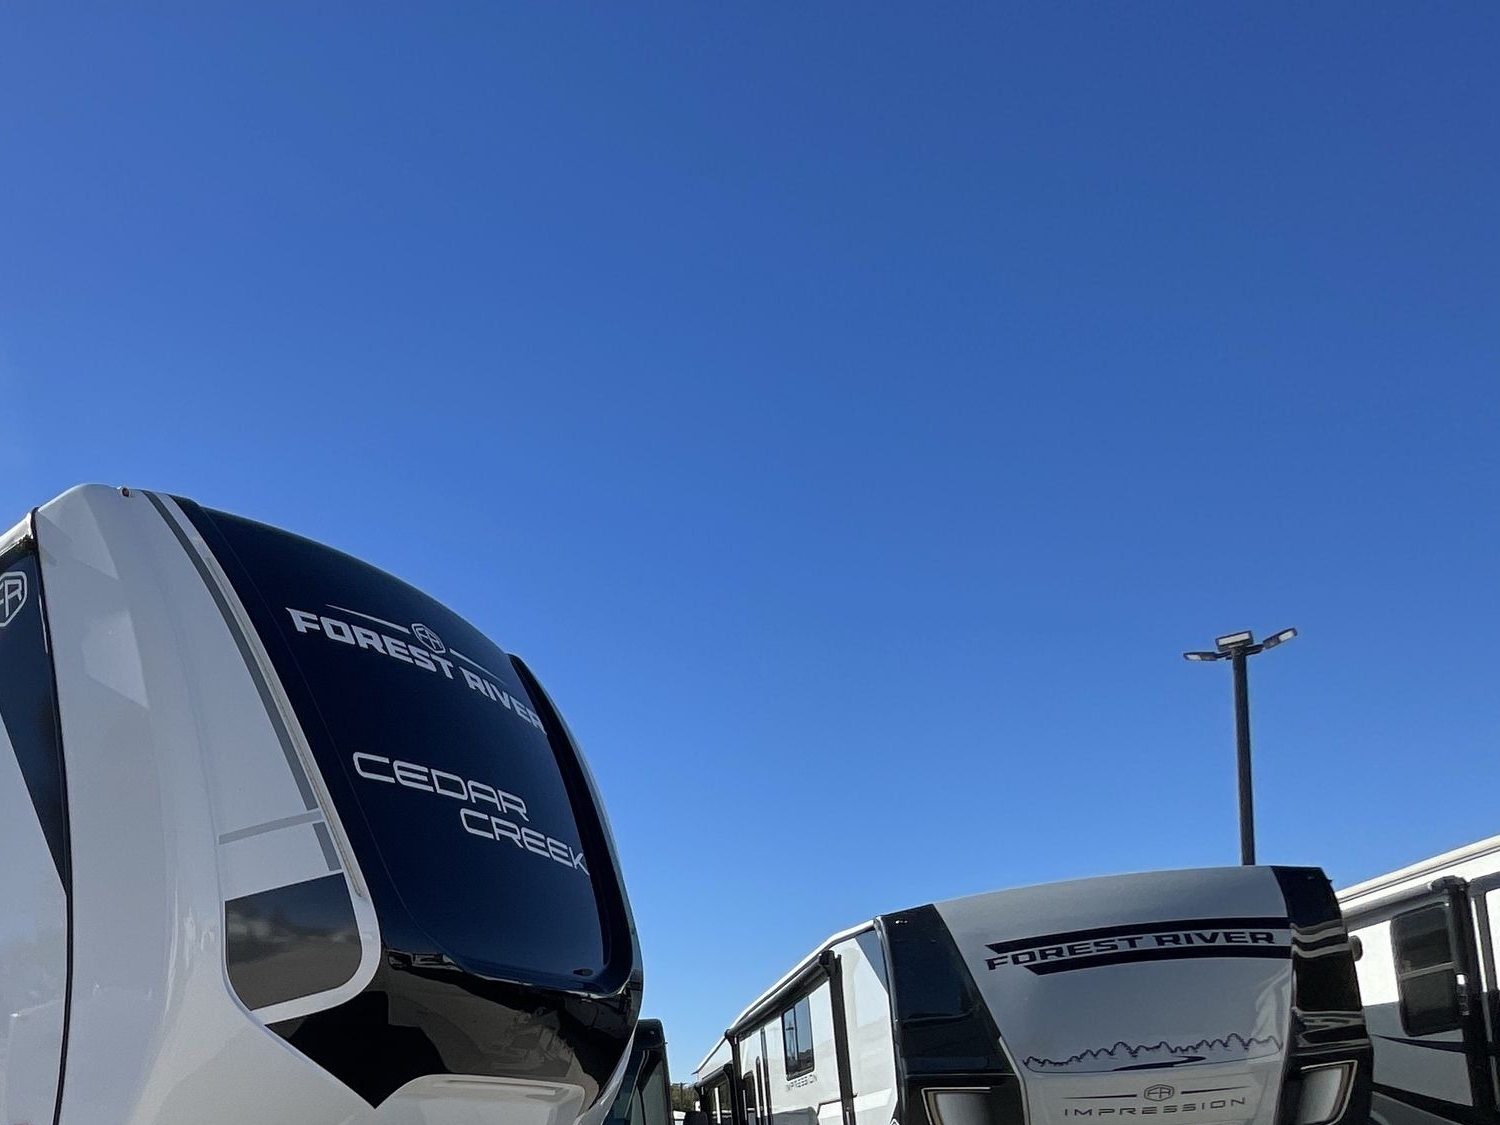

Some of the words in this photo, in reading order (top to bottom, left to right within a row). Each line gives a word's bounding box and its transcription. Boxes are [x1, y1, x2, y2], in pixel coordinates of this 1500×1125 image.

[285, 607, 453, 679] FOREST
[459, 666, 547, 735] RIVER
[353, 752, 530, 822] CEDAR
[460, 808, 589, 875] CREEK
[985, 936, 1143, 971] FOREST
[1155, 931, 1275, 946] RIVER
[1064, 1097, 1246, 1116] IMPRESSION
